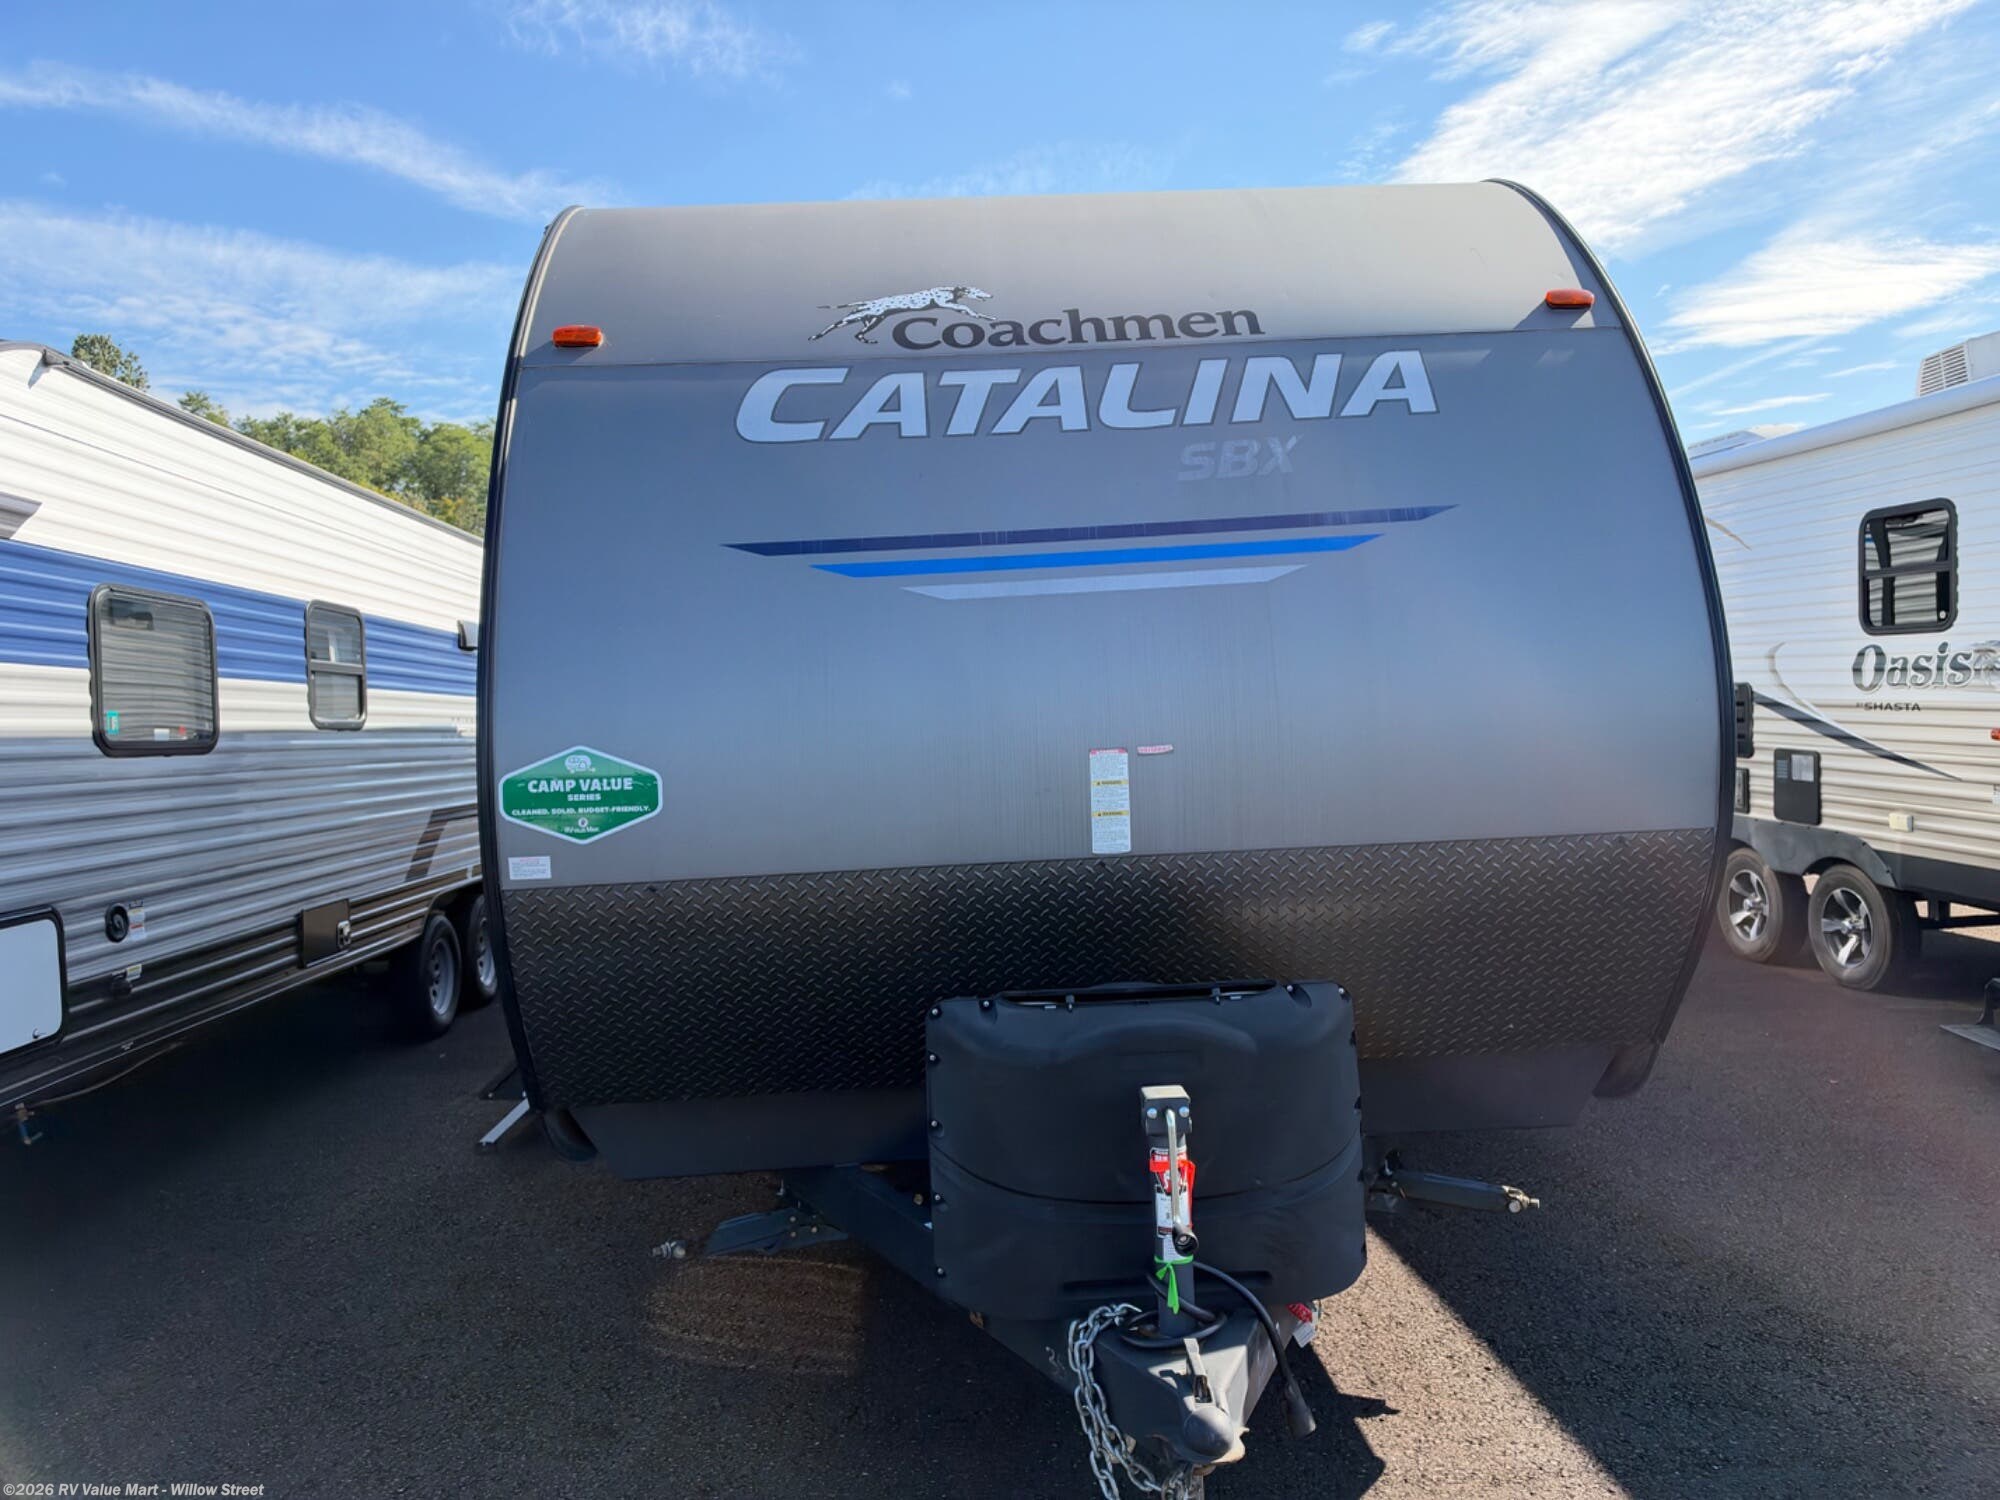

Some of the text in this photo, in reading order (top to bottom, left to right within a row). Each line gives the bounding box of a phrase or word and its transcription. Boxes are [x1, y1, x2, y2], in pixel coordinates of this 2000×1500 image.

[892, 308, 1264, 350] Coachmen
[734, 349, 1440, 444] CATALINA
[1177, 434, 1302, 481] SBX
[1852, 641, 1973, 692] Oasis
[1864, 702, 1921, 711] SHASTA
[527, 777, 633, 793] CAMP VALUE
[567, 793, 601, 801] SERIES
[512, 808, 550, 816] CLEANED.
[551, 807, 577, 815] SOLID.
